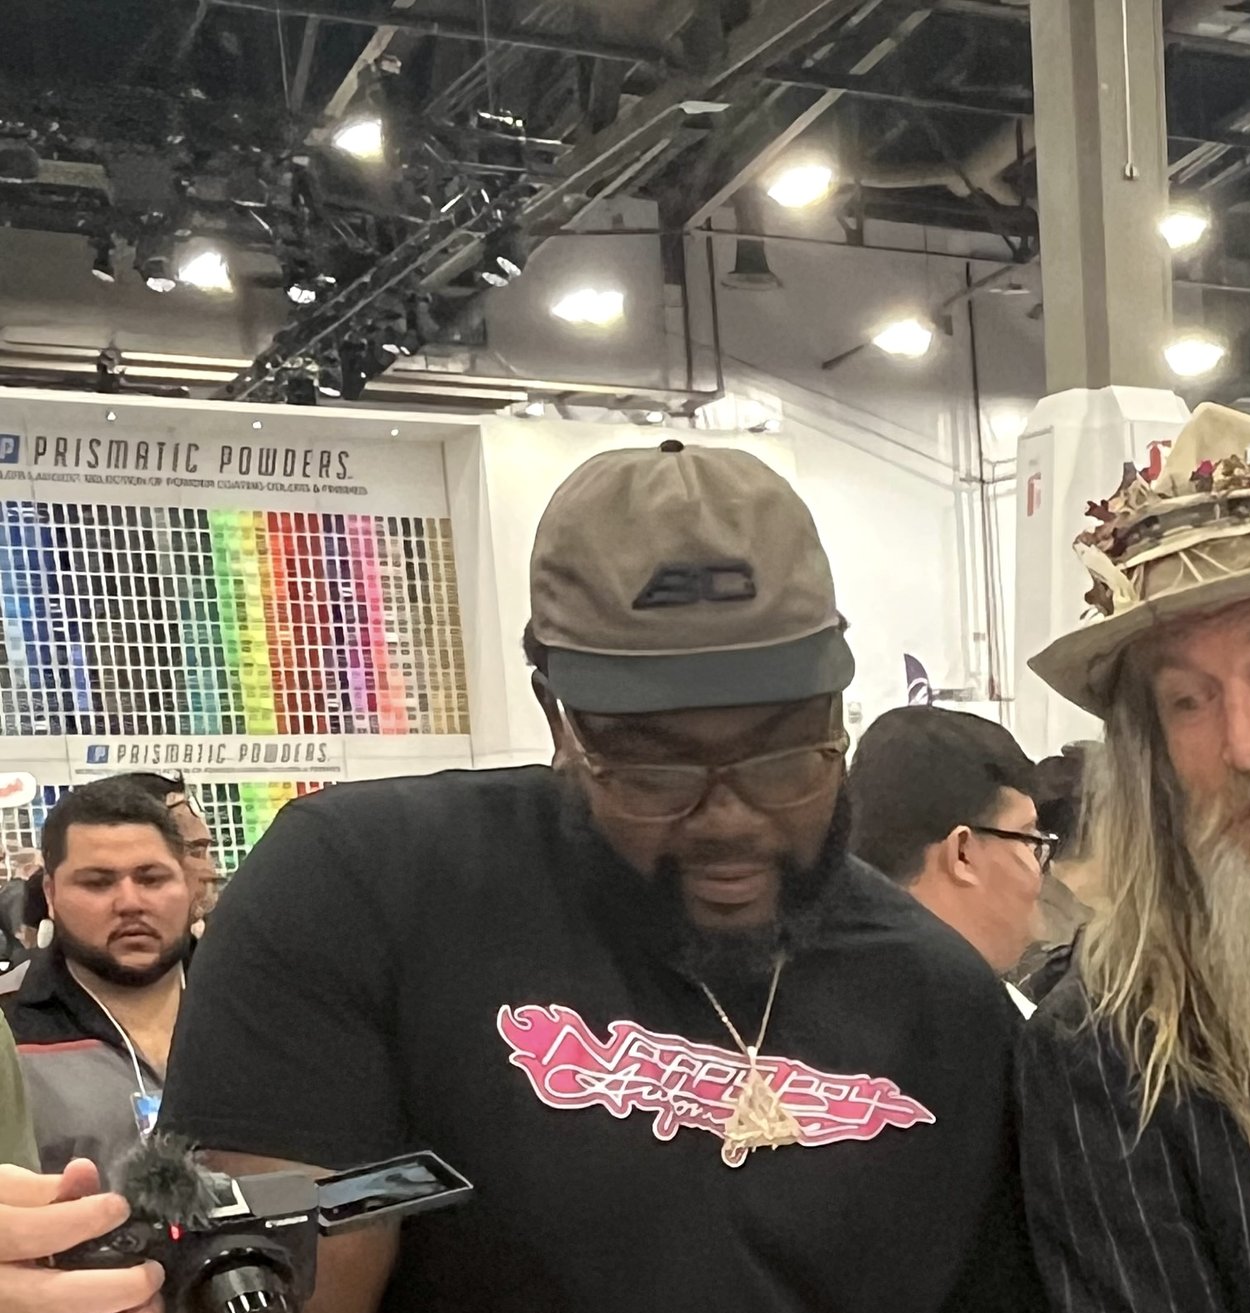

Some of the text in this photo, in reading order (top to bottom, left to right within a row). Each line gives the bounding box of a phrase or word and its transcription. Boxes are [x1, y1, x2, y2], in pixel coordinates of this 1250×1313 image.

[33, 435, 200, 473] PRISMATIC
[219, 444, 350, 480] POWDERS
[238, 742, 327, 764] PODERS
